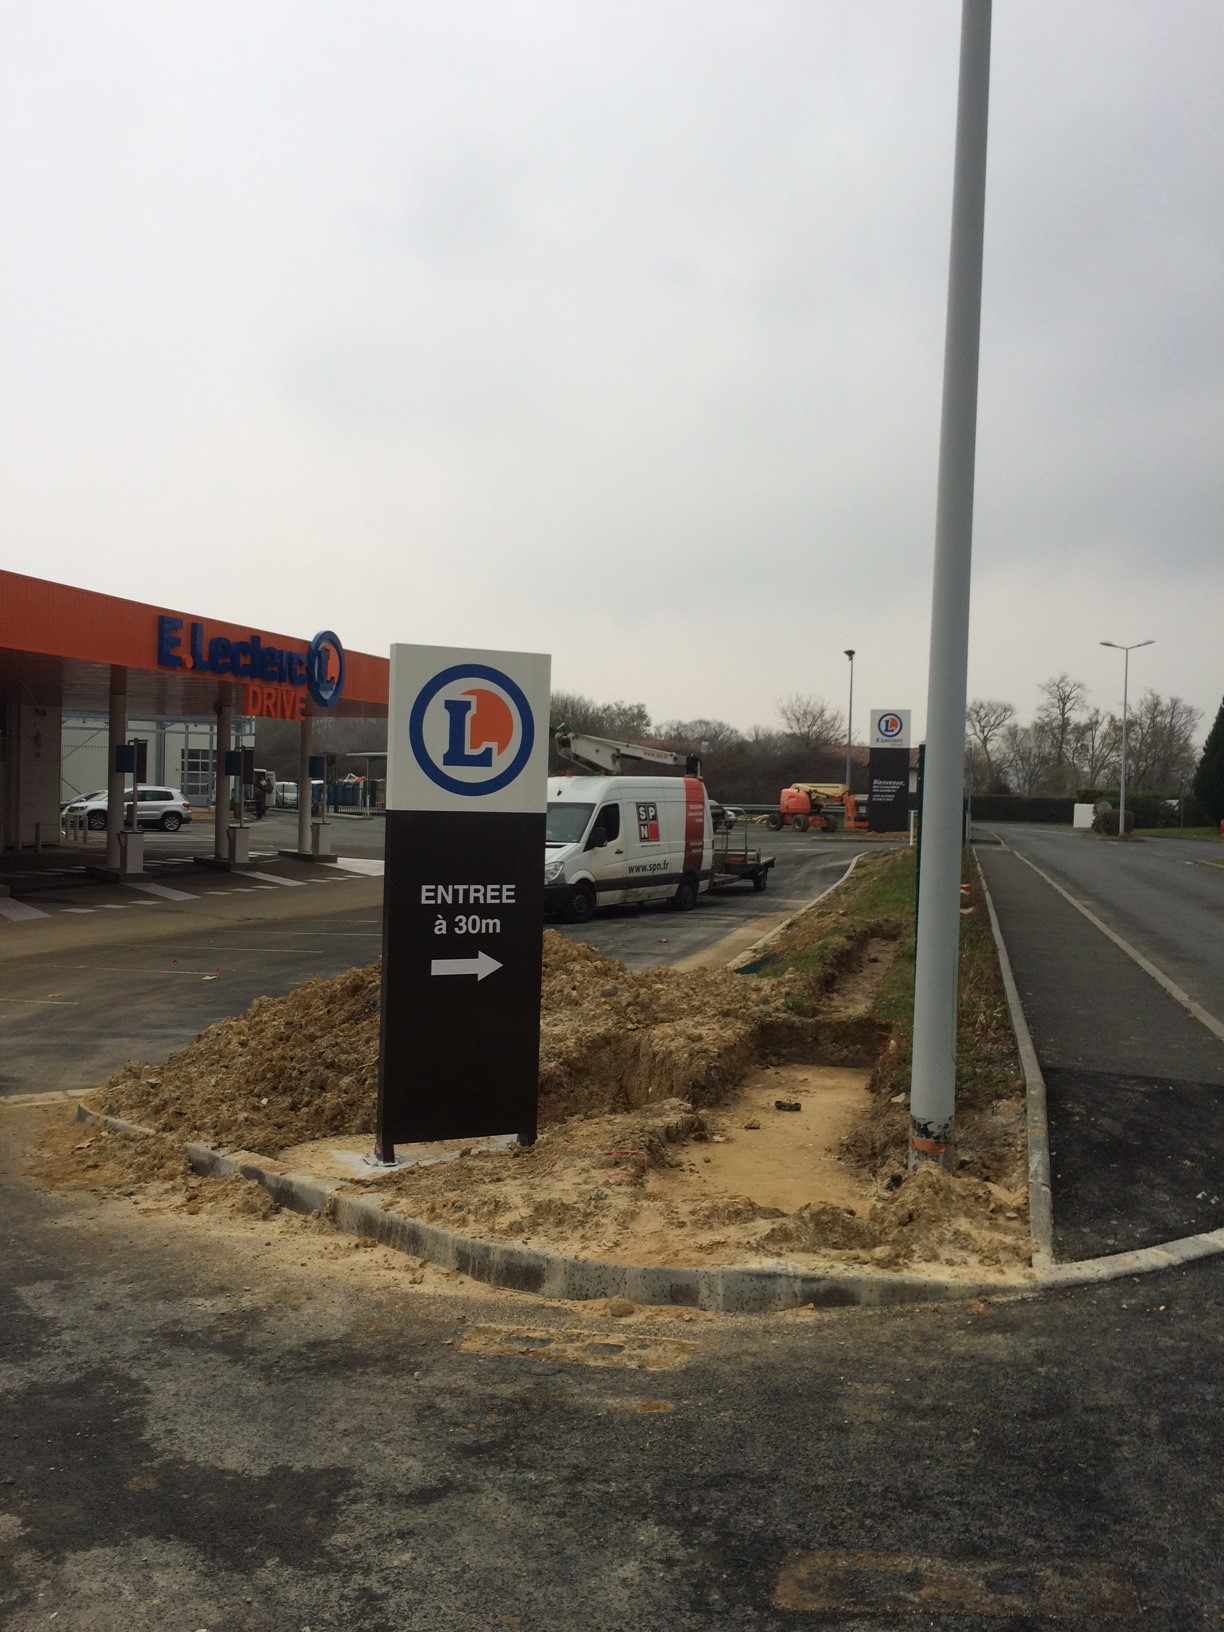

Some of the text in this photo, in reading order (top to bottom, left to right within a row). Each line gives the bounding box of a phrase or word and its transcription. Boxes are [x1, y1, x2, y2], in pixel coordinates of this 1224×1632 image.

[242, 684, 307, 722] DRIVE
[442, 698, 493, 768] L
[628, 859, 670, 874] www.spn.fr
[420, 883, 516, 906] ENTREE
[433, 914, 502, 935] à 30m
